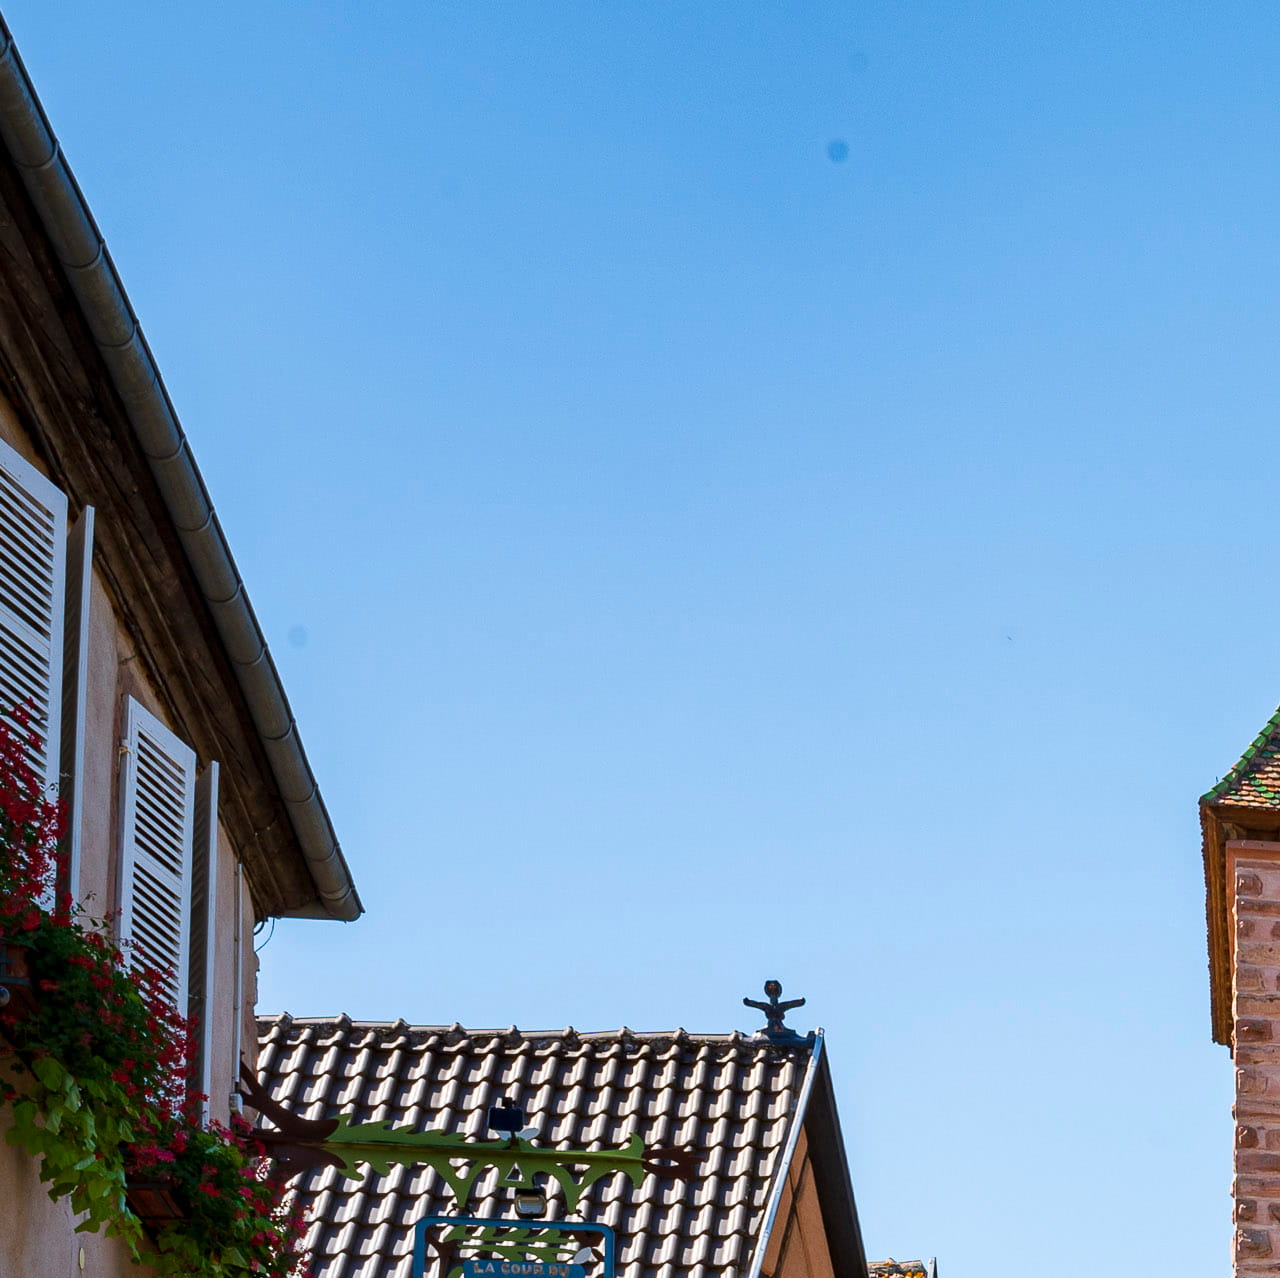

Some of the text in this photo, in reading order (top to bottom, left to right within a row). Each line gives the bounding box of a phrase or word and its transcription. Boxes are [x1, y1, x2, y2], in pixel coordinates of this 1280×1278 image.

[473, 1262, 570, 1277] LA COUR DU
